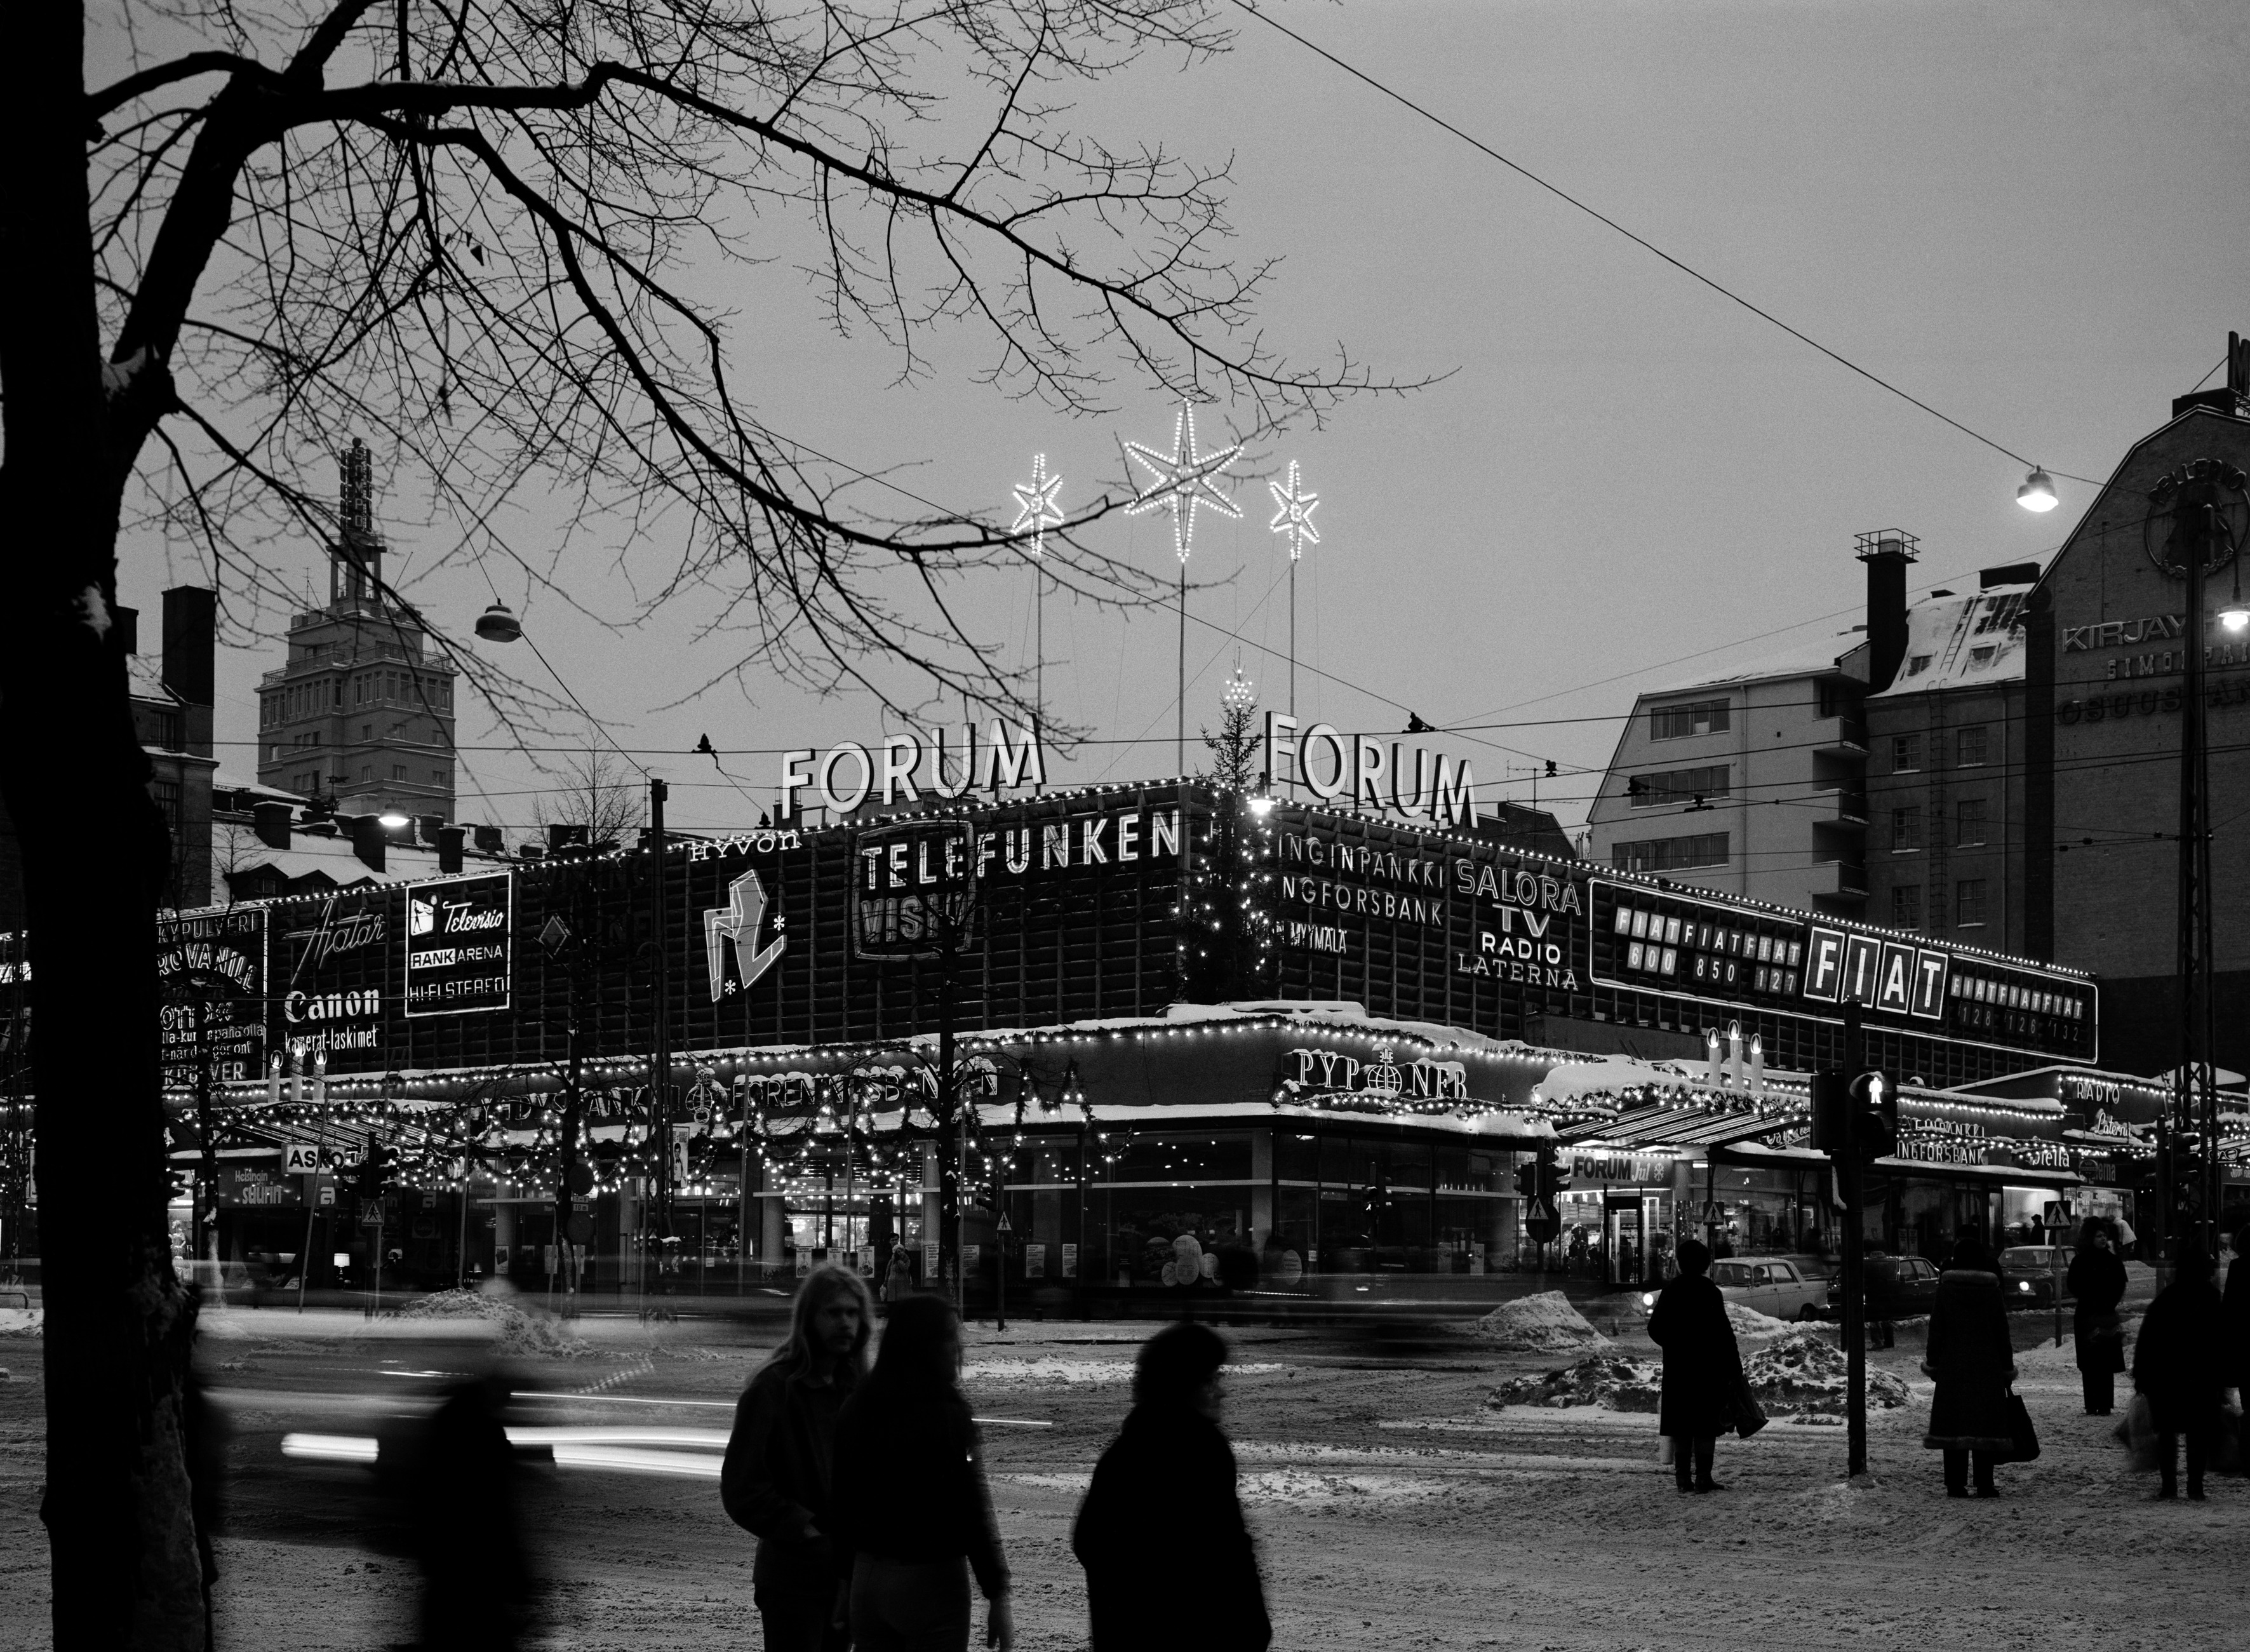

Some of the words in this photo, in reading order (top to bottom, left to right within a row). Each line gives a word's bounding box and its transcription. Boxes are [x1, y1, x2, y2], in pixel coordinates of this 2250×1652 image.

[782, 713, 1046, 819] FORUM
[1266, 711, 1478, 829] FORUM
[862, 809, 1182, 890] TELEFUNKEN
[1457, 861, 1581, 916] SALORA
[442, 900, 506, 934] Televisio
[1492, 903, 1551, 938] TV
[1481, 932, 1561, 965] RADIO
[1619, 911, 1678, 940] FIAT
[1685, 924, 1740, 952] FIAT
[1747, 937, 1800, 962] FIAT
[412, 950, 455, 968] RANK
[455, 944, 504, 962] ARENA
[1457, 953, 1579, 991] LATERNA
[1631, 946, 1672, 972] 600
[1696, 958, 1735, 983] 850
[1758, 969, 1795, 992] 127
[409, 984, 441, 1003] HI-FI
[445, 977, 505, 998] STEREO
[1816, 940, 1941, 1008] FIAT
[284, 988, 379, 1023] Canon
[1952, 977, 1997, 1001] FIAT
[1999, 990, 2040, 1009] FIAT
[2044, 998, 2082, 1017] FIAT
[243, 1024, 264, 1038] olla
[1962, 1006, 1991, 1026] 128
[2009, 1014, 2036, 1034] 126
[2052, 1023, 2079, 1042] 132
[1299, 1052, 1360, 1091] PYP
[1412, 1064, 1467, 1099] NFB
[2077, 1082, 2120, 1105] RADIO
[235, 1169, 268, 1185] Helsingin
[1573, 1155, 1631, 1180] FORUM
[1631, 1161, 1651, 1183] Jul
[242, 1181, 282, 1205] suurin
